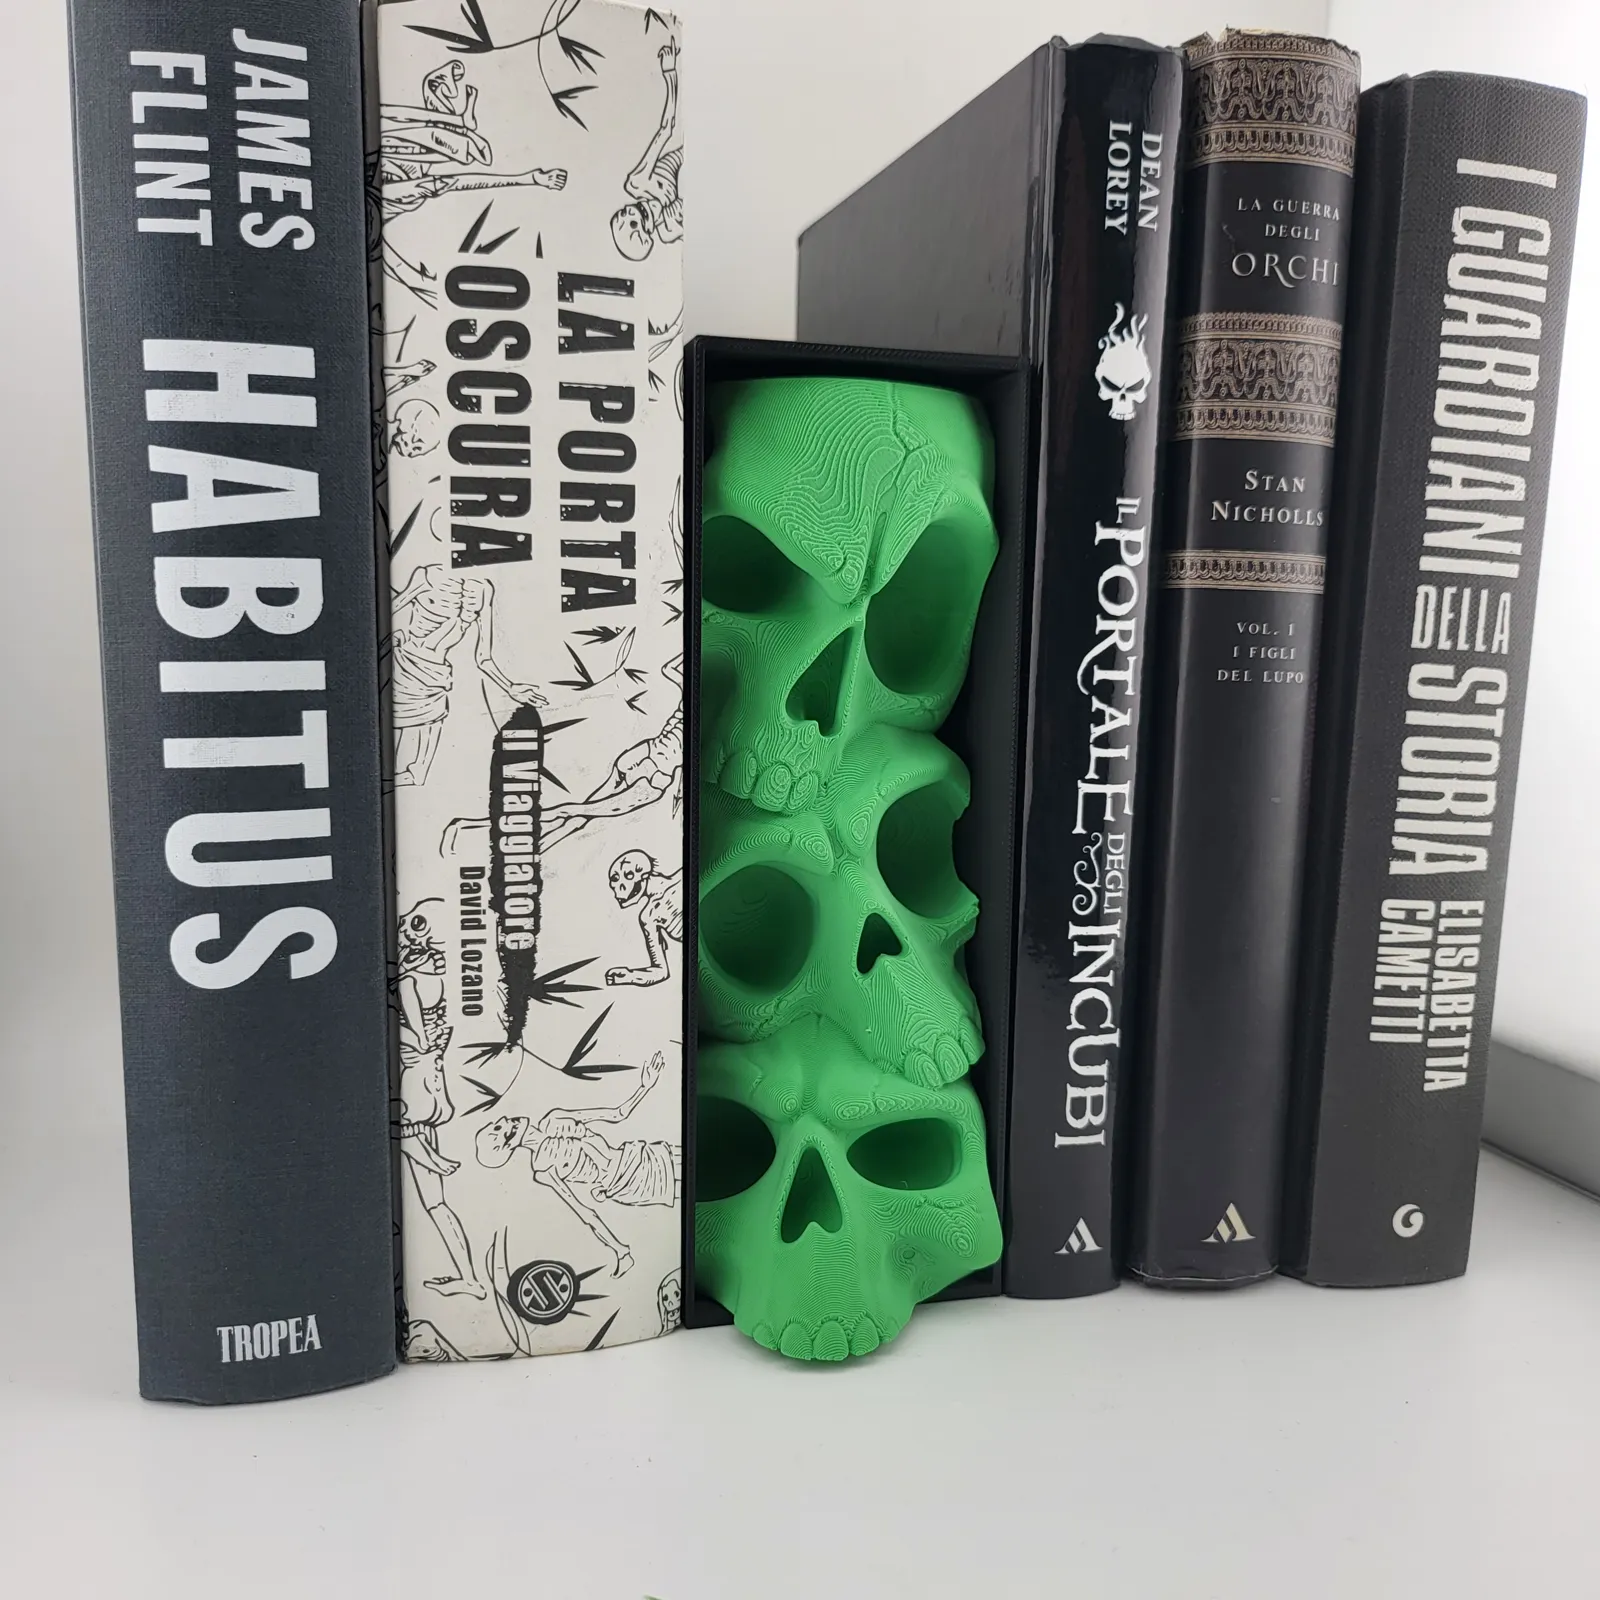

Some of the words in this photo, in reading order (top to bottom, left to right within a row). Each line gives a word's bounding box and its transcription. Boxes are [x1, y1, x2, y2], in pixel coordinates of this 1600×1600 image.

[130, 50, 213, 247] FLINT
[232, 28, 316, 251] JAMES
[1104, 120, 1132, 236] LOREY
[1140, 131, 1163, 232] DEAN
[1456, 158, 1557, 190] I
[1237, 197, 1262, 212] LA
[1273, 199, 1340, 221] GUERRA
[1265, 223, 1321, 242] DEGLI
[1232, 252, 1339, 289] ORCHI
[557, 271, 635, 356] LA
[444, 264, 533, 569] OSCURA
[1418, 205, 1551, 579] GUARDIANI
[557, 381, 638, 613] PORTA
[1115, 497, 1142, 524] IL
[1233, 645, 1240, 658] I
[1249, 646, 1297, 660] FIGLI
[1236, 621, 1280, 636] VOL.
[1410, 584, 1511, 655] DELLA
[142, 338, 338, 990] HABITUS
[1072, 520, 1147, 836] PORTALE
[1217, 669, 1253, 682] DEL
[1262, 670, 1304, 684] LUPO
[502, 729, 538, 751] Il
[1388, 664, 1507, 876] STORIA
[499, 760, 542, 951] Viaggiatore
[1103, 833, 1127, 914] DEGLI
[460, 866, 486, 932] David
[460, 938, 486, 1018] Lozano
[1369, 899, 1435, 1044] CAMETTI
[1423, 900, 1485, 1093] ELISABETTA
[1054, 919, 1124, 1149] INCUBI
[217, 1314, 323, 1364] TROPEA
